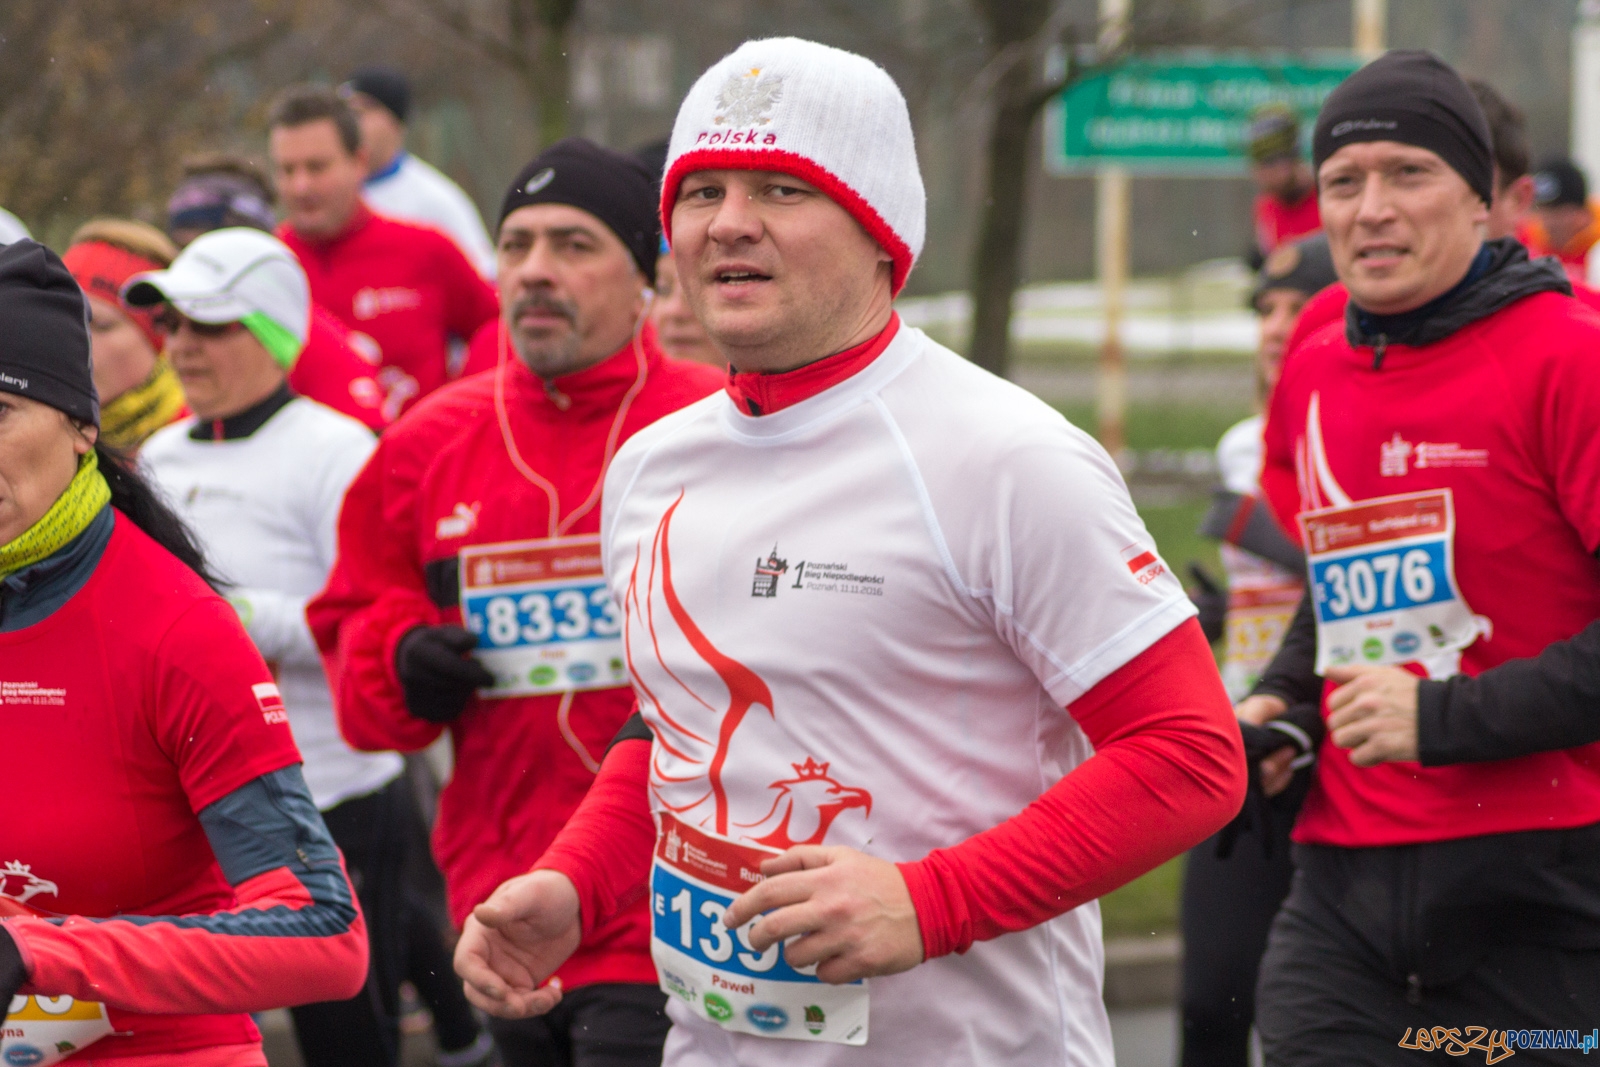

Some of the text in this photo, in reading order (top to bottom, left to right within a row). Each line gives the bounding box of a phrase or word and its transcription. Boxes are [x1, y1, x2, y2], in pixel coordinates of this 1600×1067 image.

[0, 372, 28, 390] lenji
[792, 560, 805, 589] 1
[805, 571, 821, 580] Bieg
[807, 562, 847, 571] Poznański
[1324, 549, 1436, 617] 3076
[485, 588, 621, 646] 8333
[655, 888, 818, 977] E 139
[711, 974, 756, 996] Paweł
